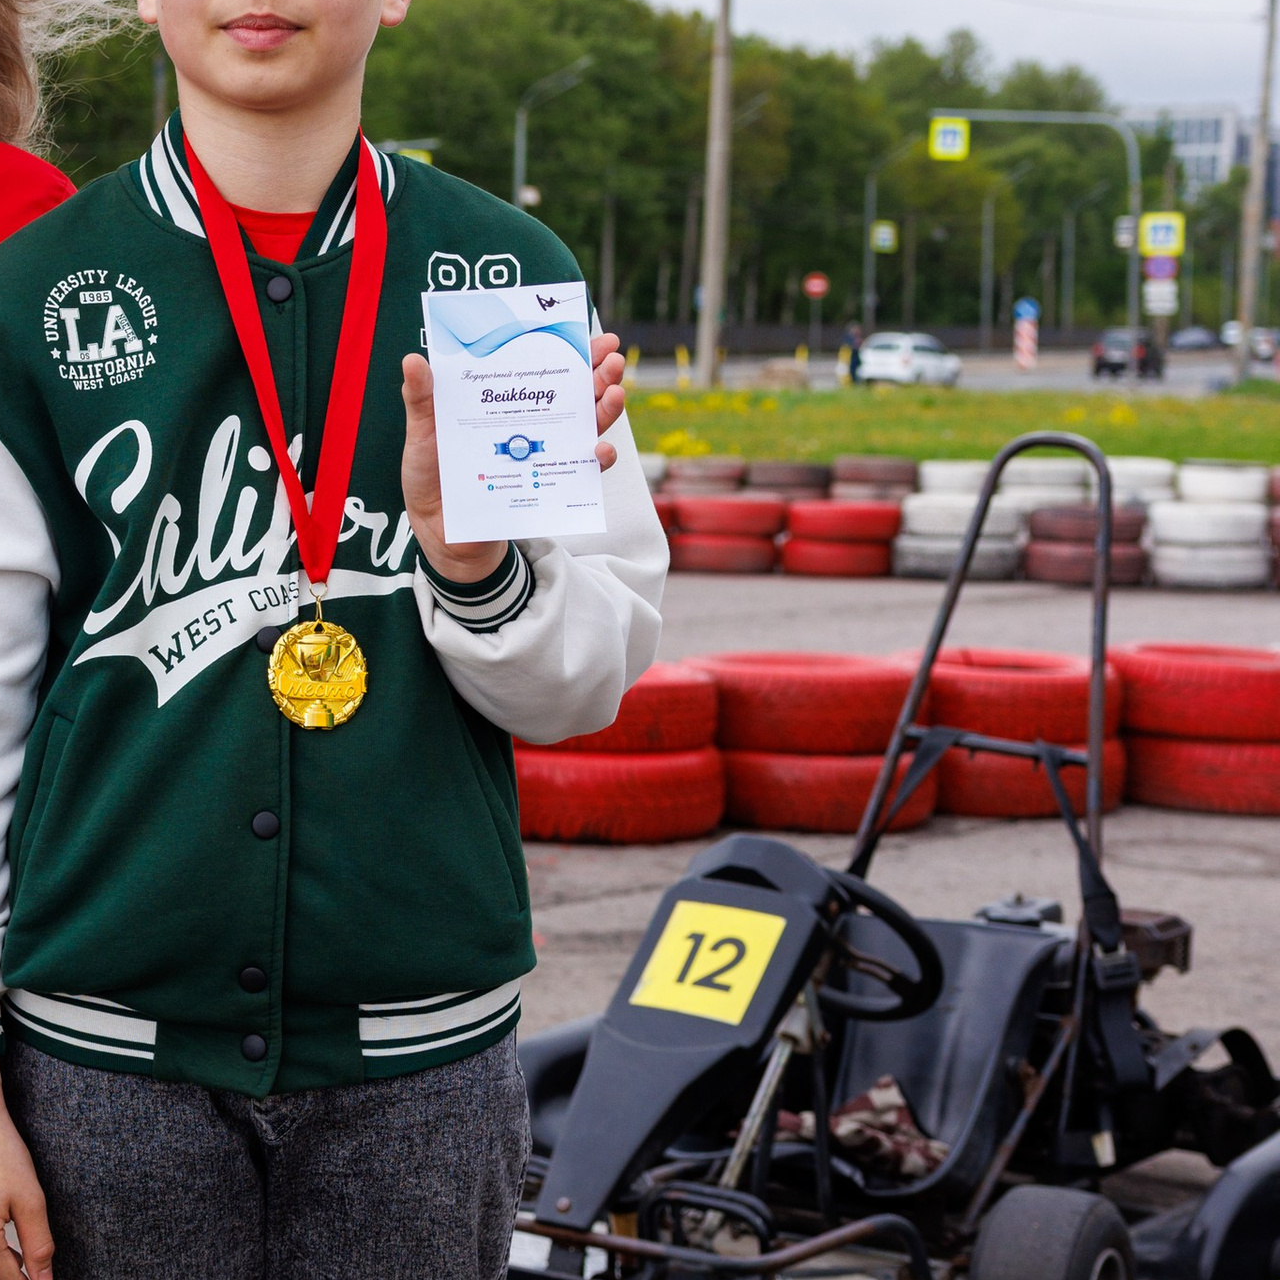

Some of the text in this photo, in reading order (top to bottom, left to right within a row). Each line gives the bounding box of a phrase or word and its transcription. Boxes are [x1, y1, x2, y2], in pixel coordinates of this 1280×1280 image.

[44, 270, 158, 342] UNIVERSITY LEAGUE
[82, 292, 110, 302] 1985
[59, 304, 143, 362] LA
[58, 351, 156, 379] CALIFORNIA
[73, 368, 144, 390] WEST COAST
[461, 367, 570, 382] Подарочный сертификат
[481, 387, 557, 405] Вейкборд
[148, 580, 299, 674] WEST COAS
[676, 932, 746, 992] 12
